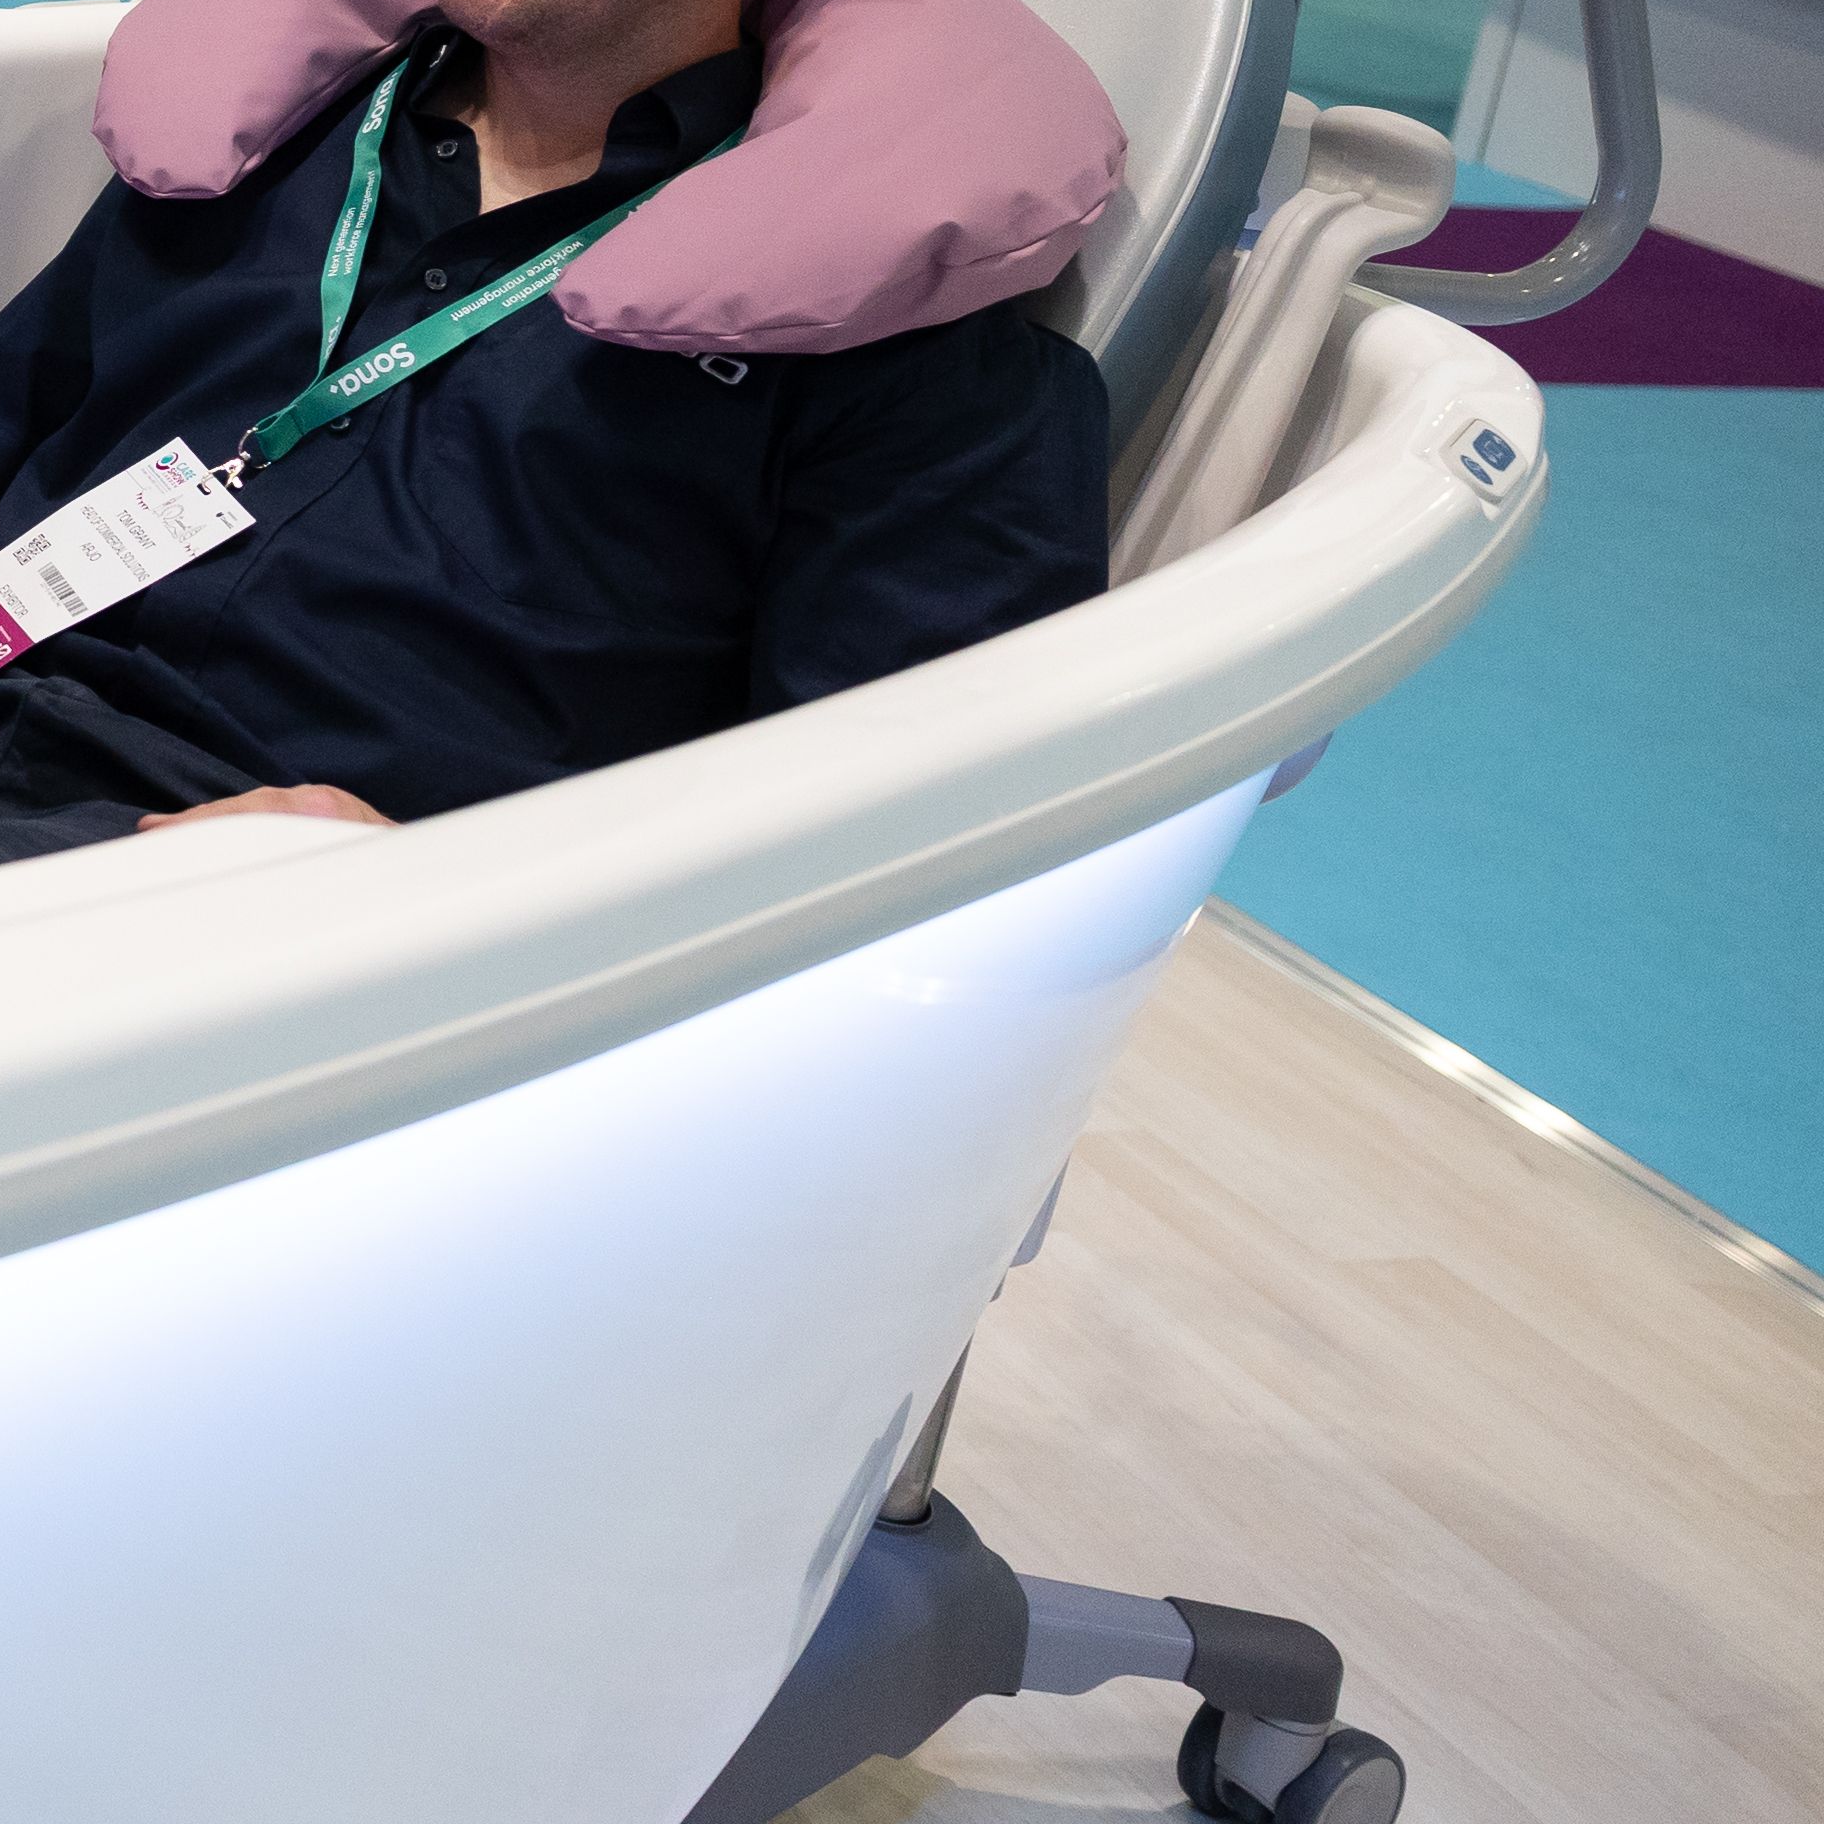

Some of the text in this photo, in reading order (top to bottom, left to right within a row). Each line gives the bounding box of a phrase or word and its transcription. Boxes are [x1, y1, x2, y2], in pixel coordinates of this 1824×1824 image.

[327, 207, 355, 278] Next generation
[343, 228, 361, 277] workforce
[450, 240, 584, 322] workforce management
[176, 462, 196, 480] CARE
[78, 539, 102, 563] ARJO
[115, 508, 156, 552] TOM GRANT
